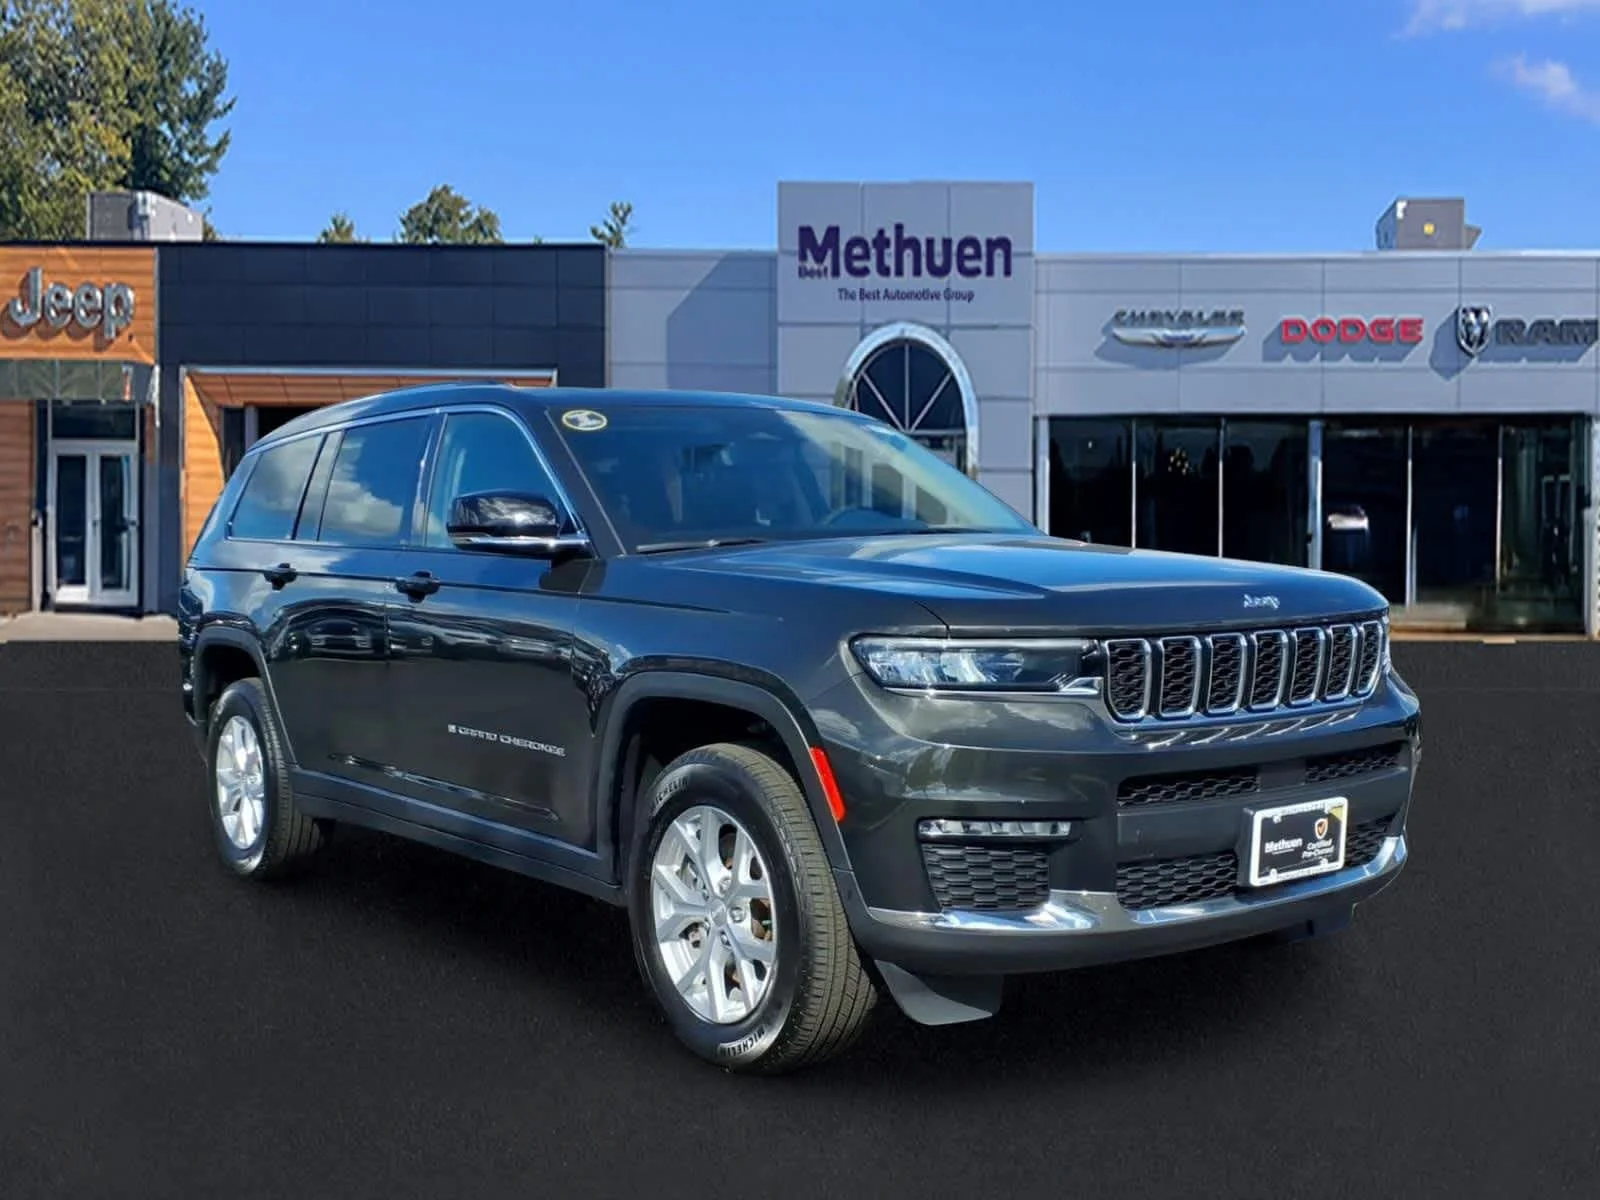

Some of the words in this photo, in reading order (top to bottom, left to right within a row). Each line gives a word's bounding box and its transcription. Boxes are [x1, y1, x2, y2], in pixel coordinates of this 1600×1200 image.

[798, 223, 1013, 278] Methuen
[9, 267, 135, 340] Jeep
[838, 287, 856, 301] The
[859, 287, 880, 301] Best
[882, 287, 941, 301] Automotive
[943, 287, 975, 303] Group
[1281, 317, 1424, 343] DODGE
[1495, 318, 1599, 346] RAM
